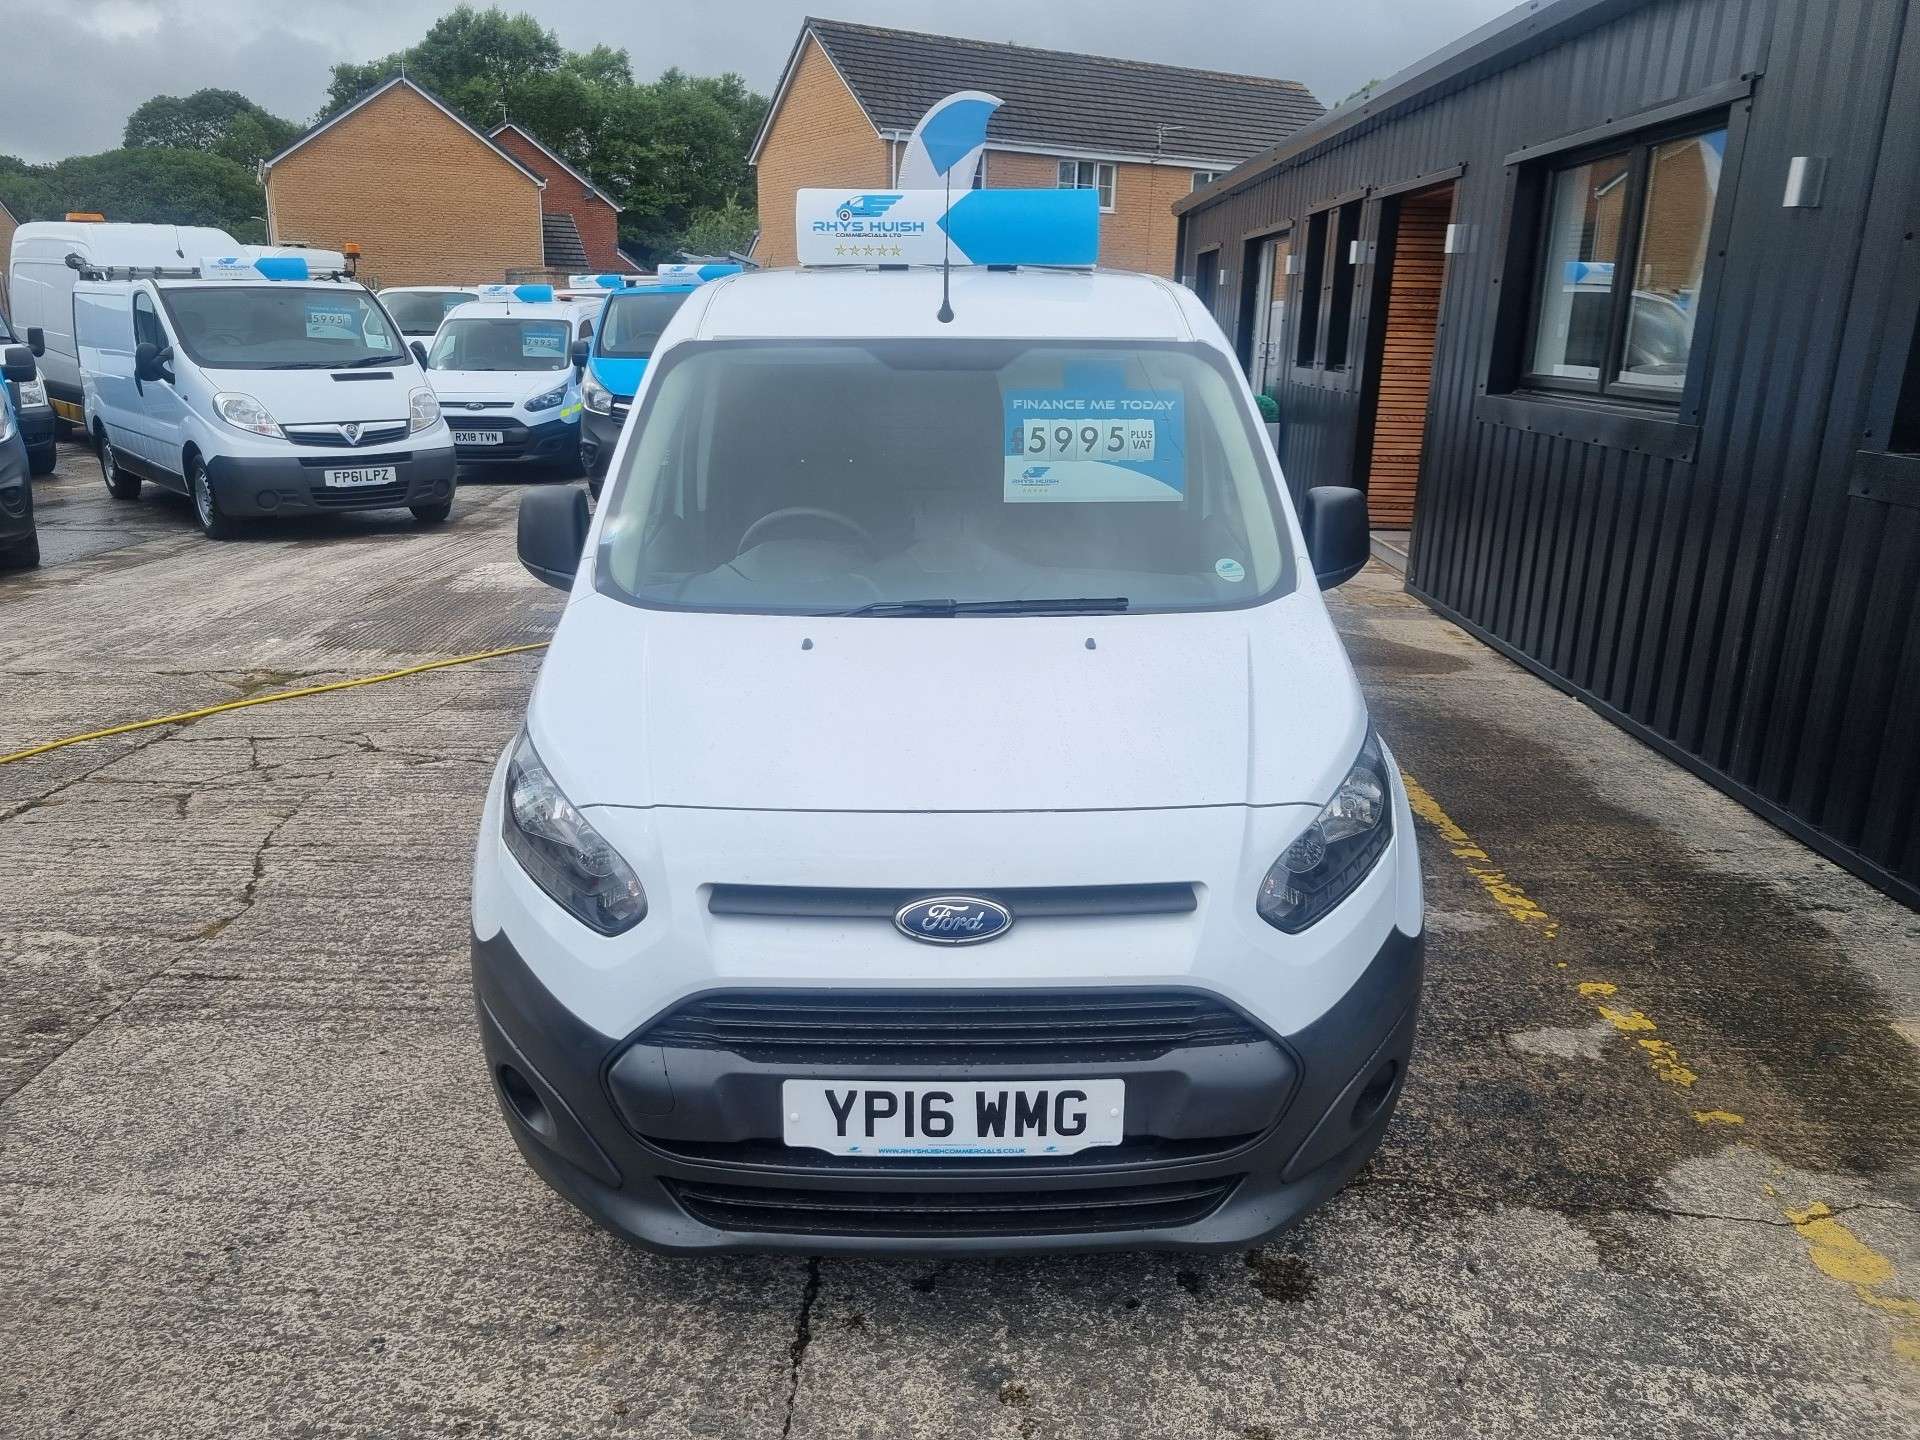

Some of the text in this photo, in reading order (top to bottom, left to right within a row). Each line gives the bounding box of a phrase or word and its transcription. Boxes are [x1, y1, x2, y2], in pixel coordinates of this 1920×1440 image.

[812, 221, 925, 232] RHYS HUISH
[312, 314, 343, 325] 5995
[1012, 399, 1176, 411] FINANCE ME TODAY
[455, 432, 498, 442] RX18 TVN
[1028, 426, 1126, 454] 5995
[1130, 430, 1153, 440] PLUS
[1132, 439, 1151, 450] VAT
[333, 469, 390, 484] FP61 LPZ
[922, 904, 985, 932] Ford
[824, 1089, 1088, 1139] YP16 WMG
